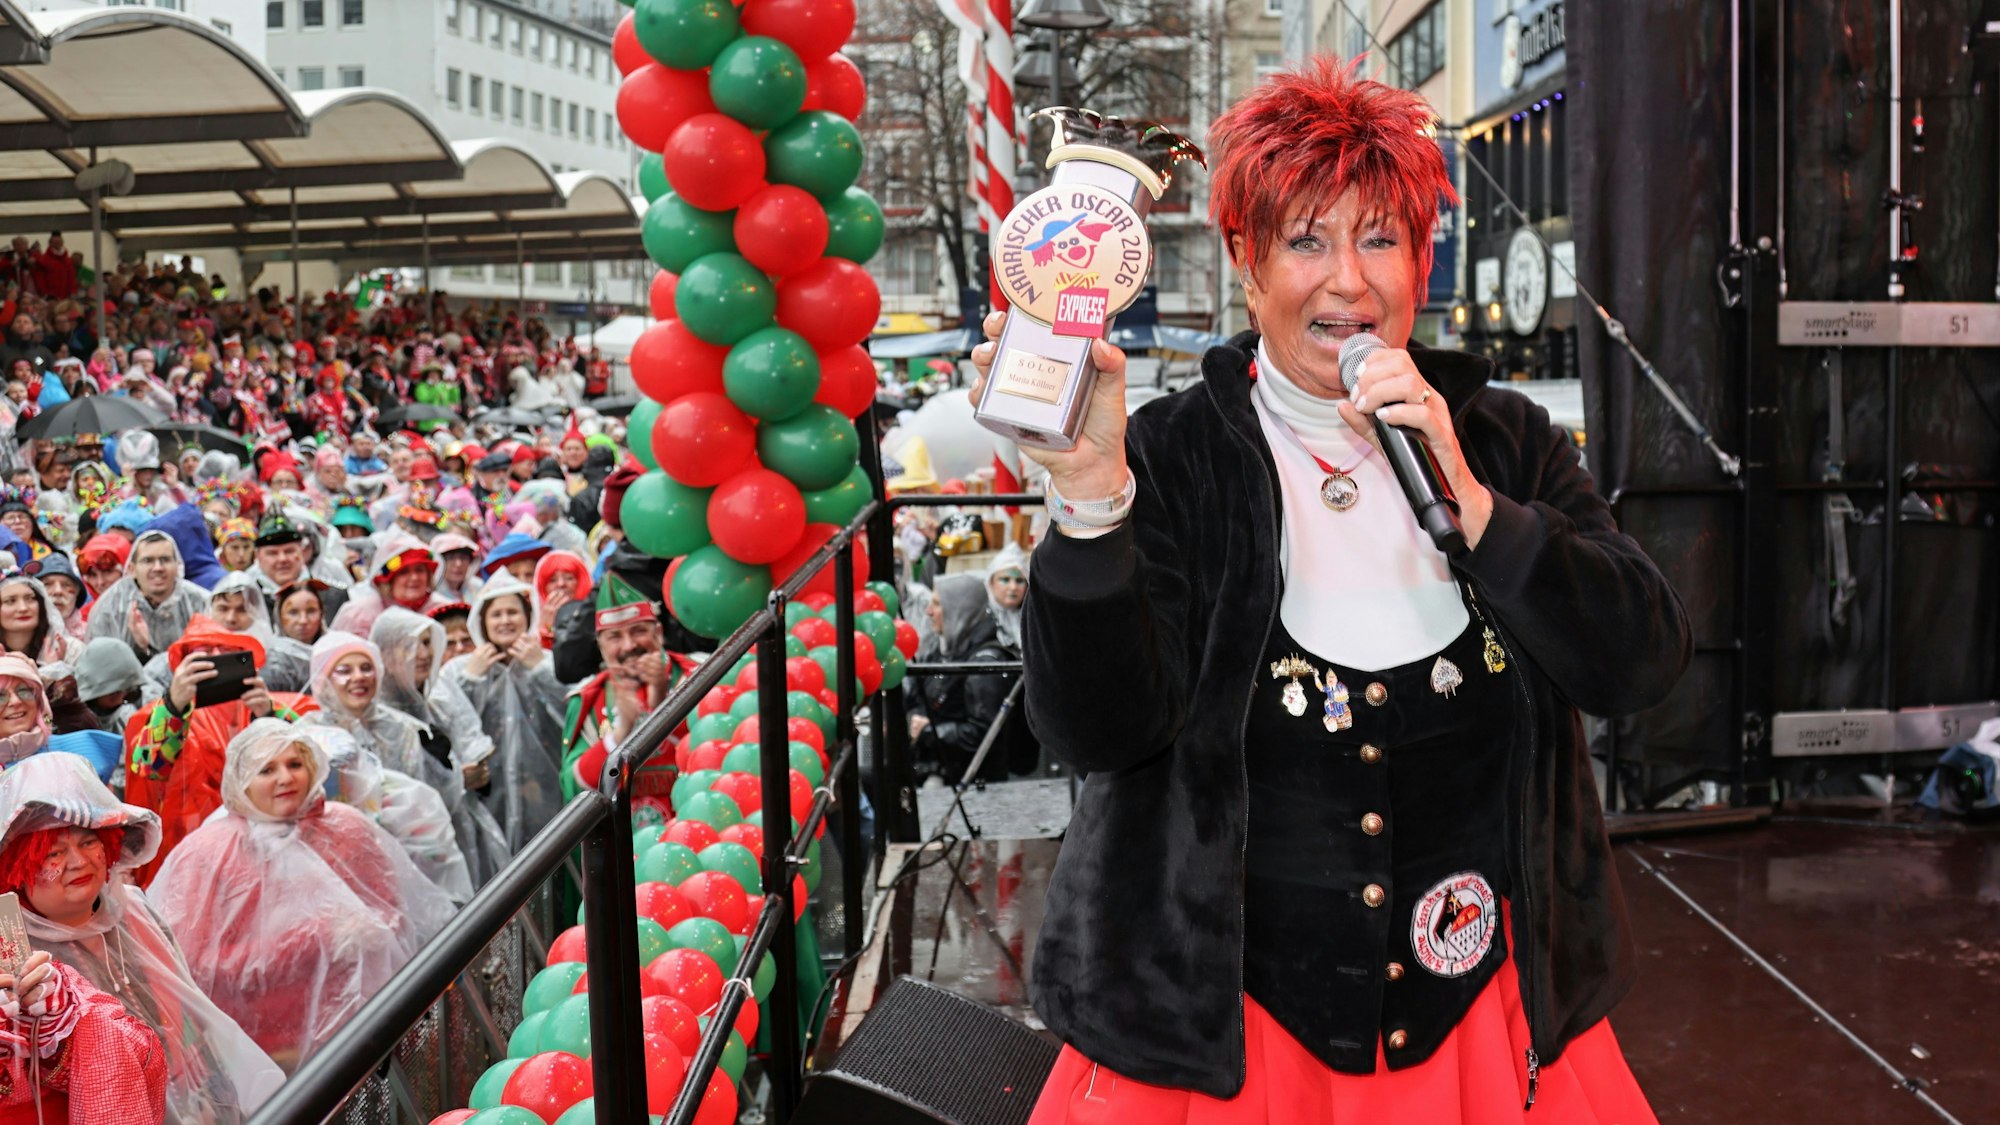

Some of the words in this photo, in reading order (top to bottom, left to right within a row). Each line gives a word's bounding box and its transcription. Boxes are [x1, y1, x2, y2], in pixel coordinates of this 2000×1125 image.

[1002, 193, 1063, 305] NÄRRISCHER
[1071, 193, 1135, 233] OSCAR
[1115, 236, 1141, 288] 2026
[1057, 293, 1106, 325] EXPRESS
[1950, 316, 1969, 334] 51
[1018, 359, 1056, 374] SOLO
[1942, 719, 1961, 738] 51
